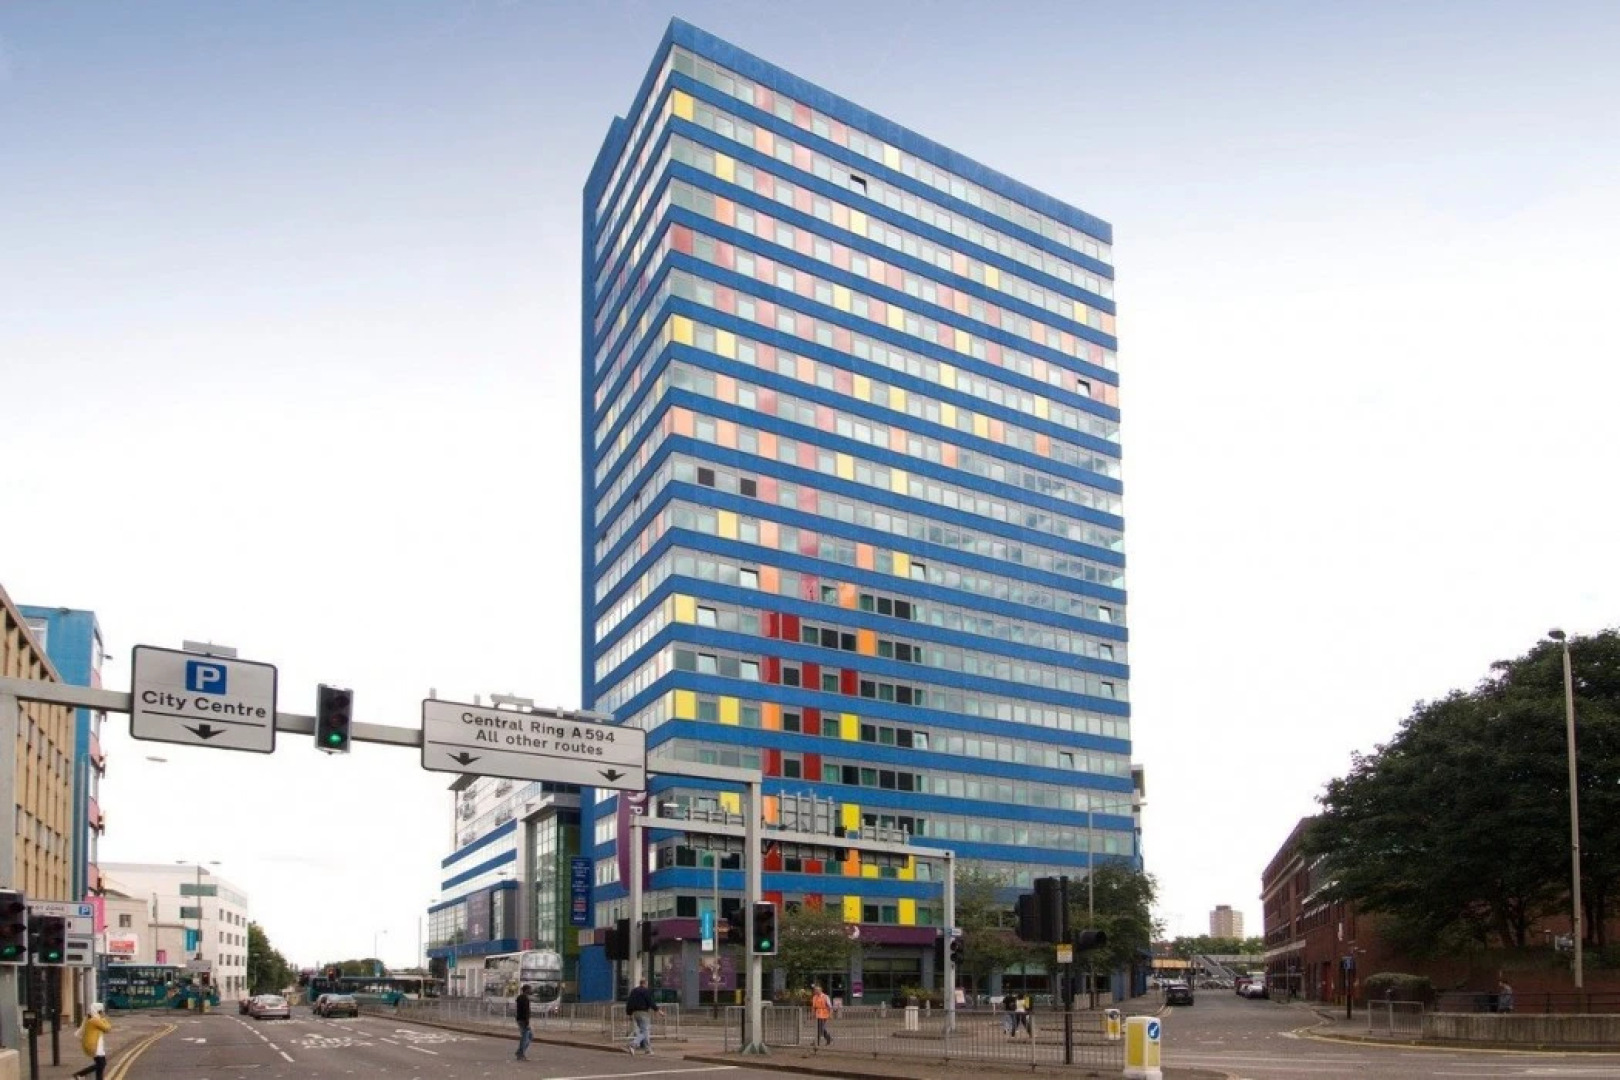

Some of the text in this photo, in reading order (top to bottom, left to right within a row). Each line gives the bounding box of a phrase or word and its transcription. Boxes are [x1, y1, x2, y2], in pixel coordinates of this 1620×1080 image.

[195, 665, 220, 690] P
[142, 690, 266, 718] City Centre
[461, 712, 524, 732] Central
[531, 720, 565, 738] Ring
[476, 729, 603, 756] All other routes
